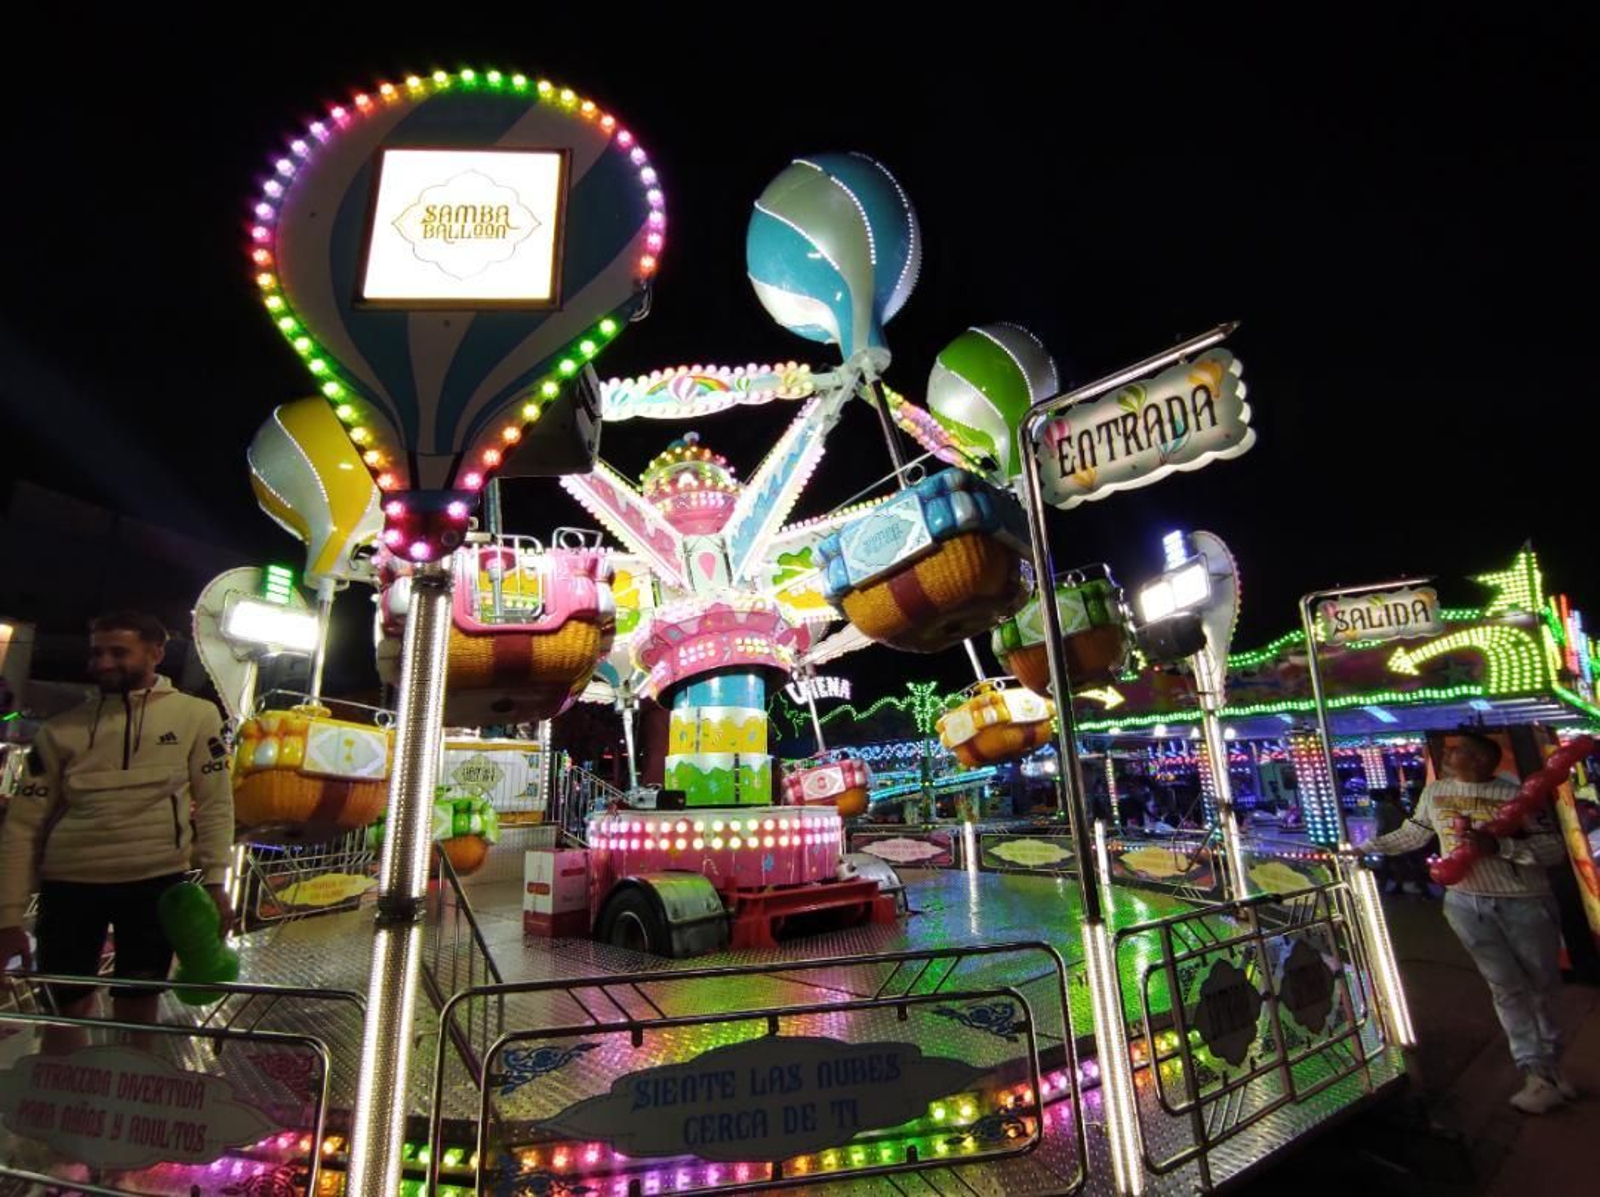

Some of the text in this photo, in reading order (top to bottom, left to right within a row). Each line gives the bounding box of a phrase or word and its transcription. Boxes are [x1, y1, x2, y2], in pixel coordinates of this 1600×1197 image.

[421, 204, 521, 229] SAMBA
[423, 224, 507, 245] BALLOON
[1057, 384, 1218, 479] ENTRADA
[1333, 599, 1431, 634] SALIDA
[630, 1052, 902, 1114] SIENTE LAS NUBES
[682, 1098, 859, 1146] CERCA DE TI
